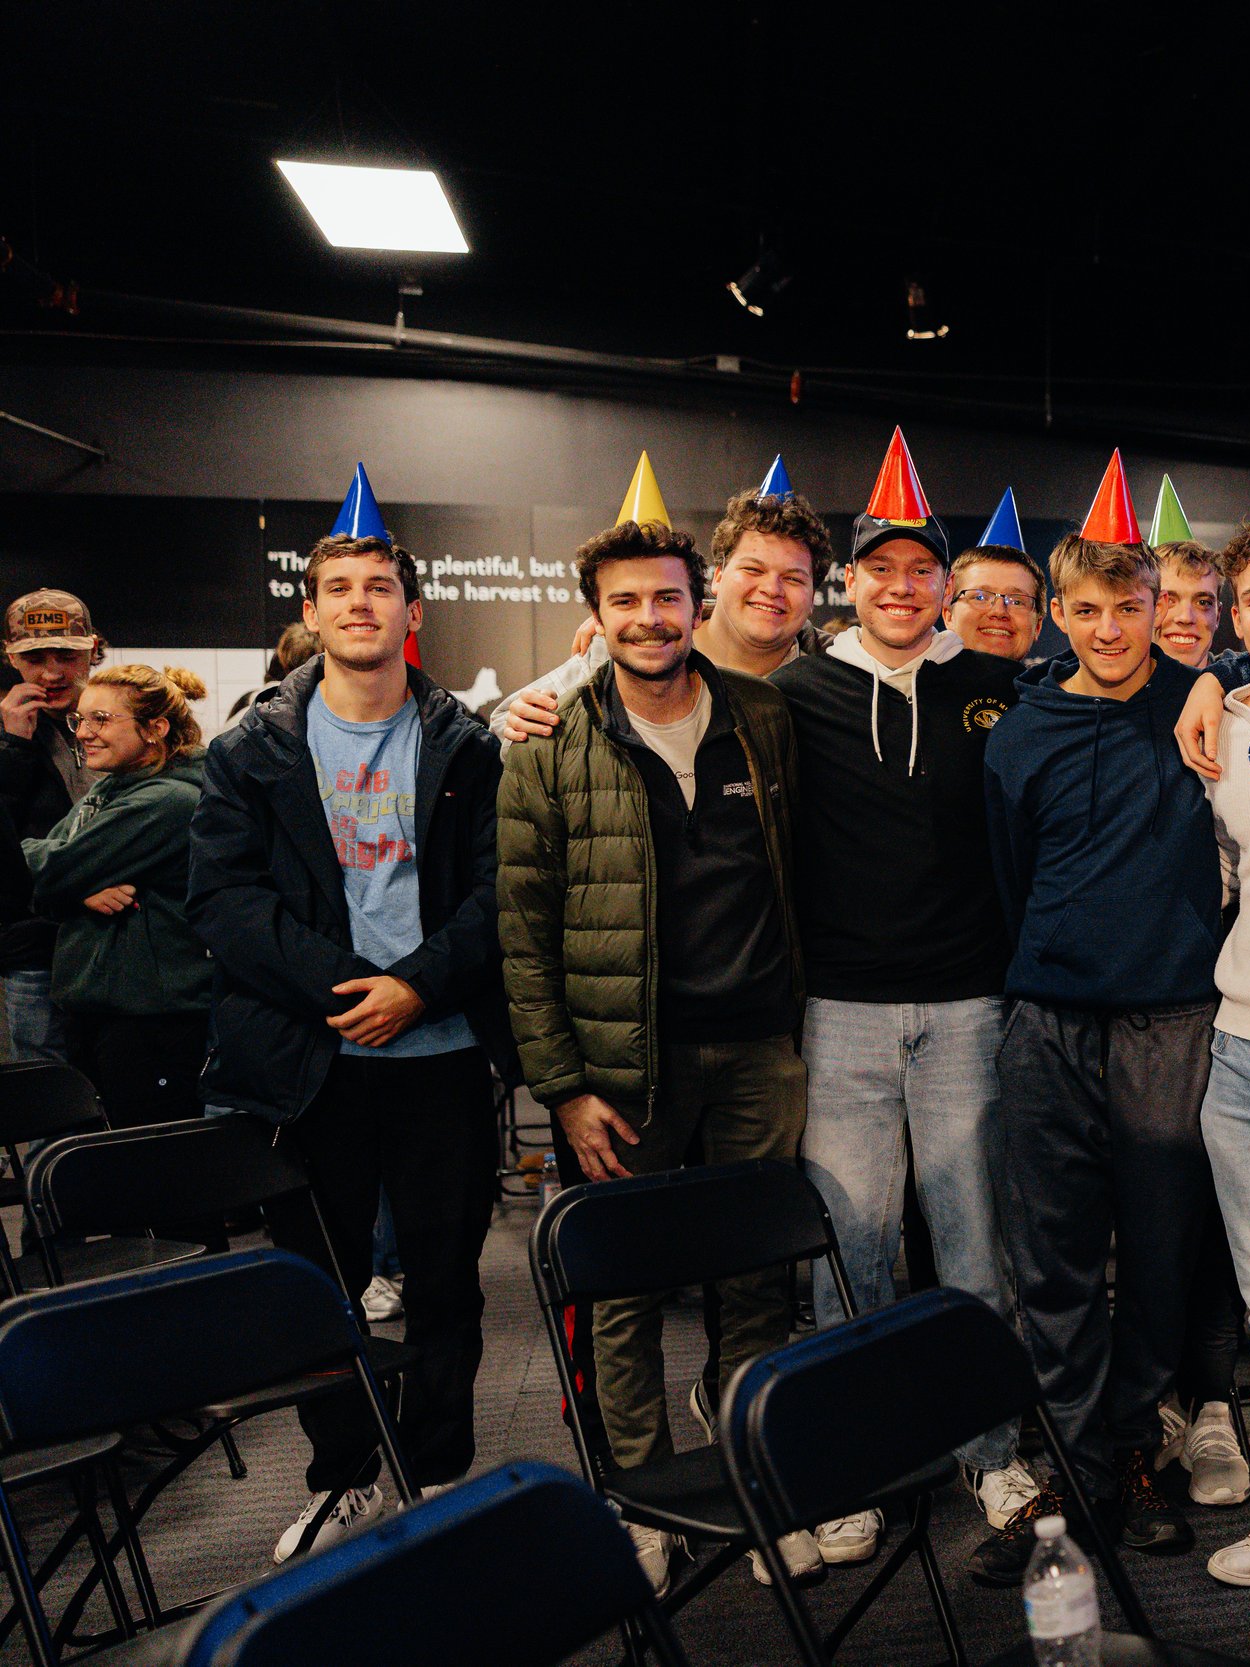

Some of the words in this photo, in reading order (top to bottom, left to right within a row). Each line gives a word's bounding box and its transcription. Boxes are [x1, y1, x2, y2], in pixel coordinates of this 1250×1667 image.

[432, 554, 524, 580] plentiful,
[530, 556, 566, 578] but
[269, 579, 295, 598] to
[422, 580, 460, 600] the
[464, 580, 543, 603] harvest
[546, 585, 571, 603] to
